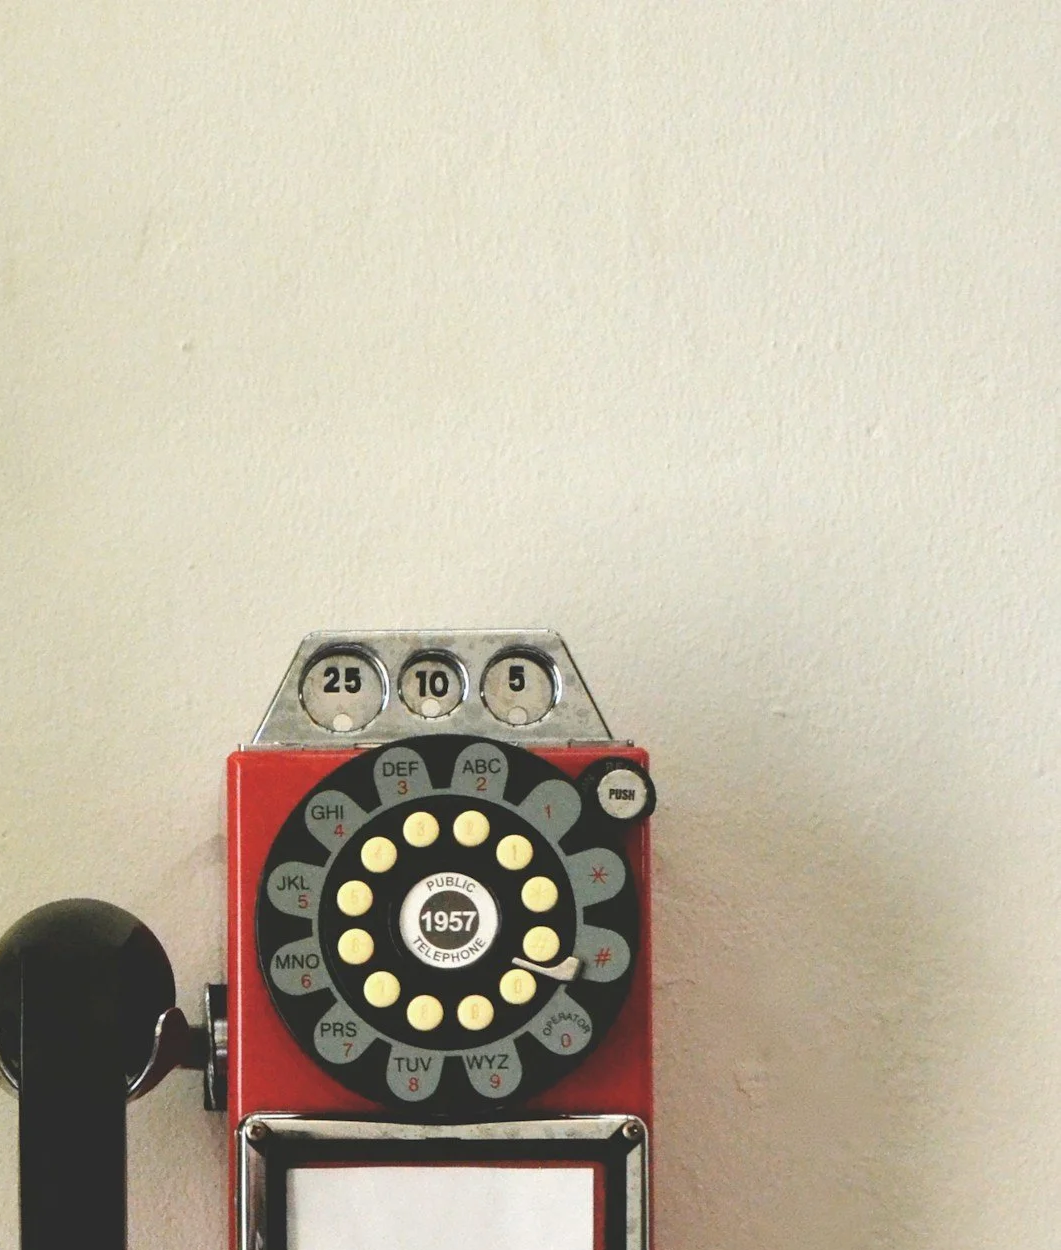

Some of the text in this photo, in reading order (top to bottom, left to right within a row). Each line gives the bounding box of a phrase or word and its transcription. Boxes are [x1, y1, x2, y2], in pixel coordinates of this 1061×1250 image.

[323, 667, 362, 693] 25
[415, 671, 449, 697] 10
[509, 665, 526, 692] 5
[382, 761, 419, 777] DEF
[462, 758, 502, 774] ABC
[397, 780, 409, 795] 3
[476, 777, 488, 791] 2
[608, 788, 635, 801] PUSH
[311, 805, 344, 820] GHI
[544, 804, 551, 819] 1
[334, 824, 344, 837] 4
[277, 876, 310, 890] JKL
[426, 877, 476, 893] PUBLIC
[298, 895, 308, 909] 5
[420, 911, 477, 932] 1957
[413, 936, 486, 963] TELEPHONE
[275, 954, 320, 969] MNO
[301, 974, 312, 989] 6
[320, 1023, 357, 1038] PRS
[542, 1012, 591, 1036] OPERATOR
[561, 1033, 571, 1048] 0
[343, 1043, 353, 1057] 7
[394, 1057, 432, 1072] TUV
[467, 1054, 510, 1070] WYZ
[408, 1077, 419, 1092] 8
[490, 1074, 501, 1089] 9
